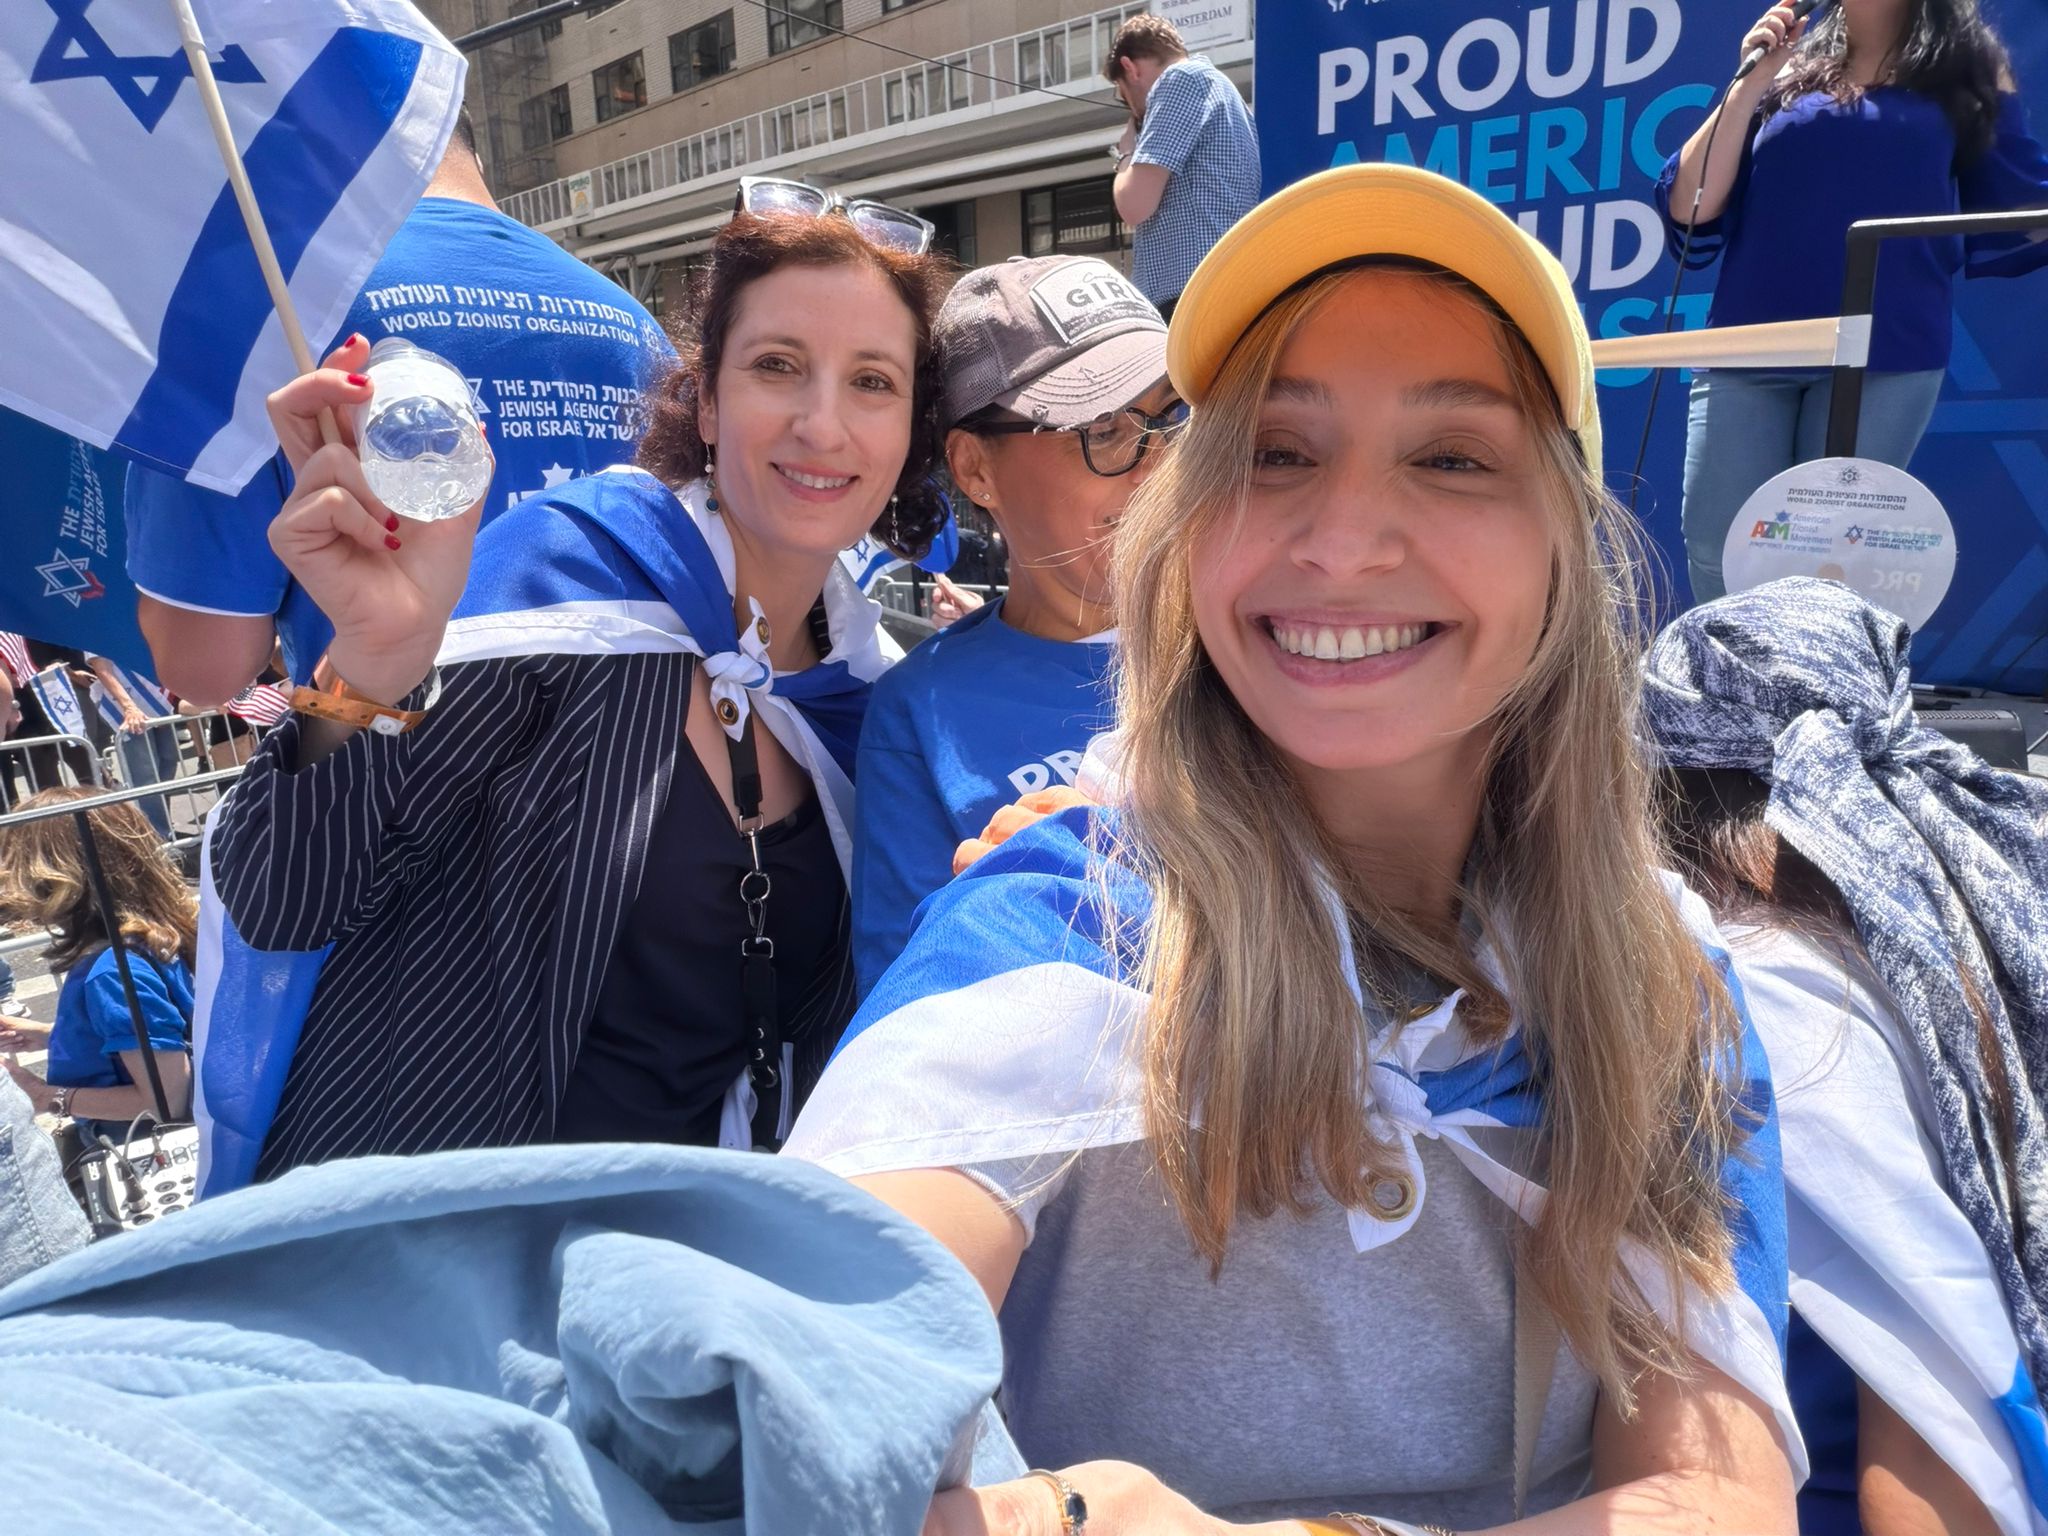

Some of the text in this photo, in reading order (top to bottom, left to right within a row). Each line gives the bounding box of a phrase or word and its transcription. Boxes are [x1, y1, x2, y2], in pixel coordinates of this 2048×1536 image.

[1318, 0, 1681, 135] PROUD
[365, 283, 637, 328] ההסתדרות הציונית העולמית
[381, 311, 639, 347] WORLD ZIONIST ORGANIZATION
[492, 380, 527, 396] THE
[530, 380, 597, 401] היהודית
[499, 401, 619, 421] JEWISH AGENCY
[501, 421, 533, 438] FOR
[584, 420, 640, 441] ישראל
[1787, 496, 1905, 511] WORLD ZIONIST ORGANIZATION
[60, 505, 80, 538] THE
[80, 486, 95, 550] JEWISH
[1793, 513, 1831, 524] American
[1751, 520, 1790, 540] AZM
[1790, 533, 1832, 545] Movement
[96, 524, 107, 558] FOR
